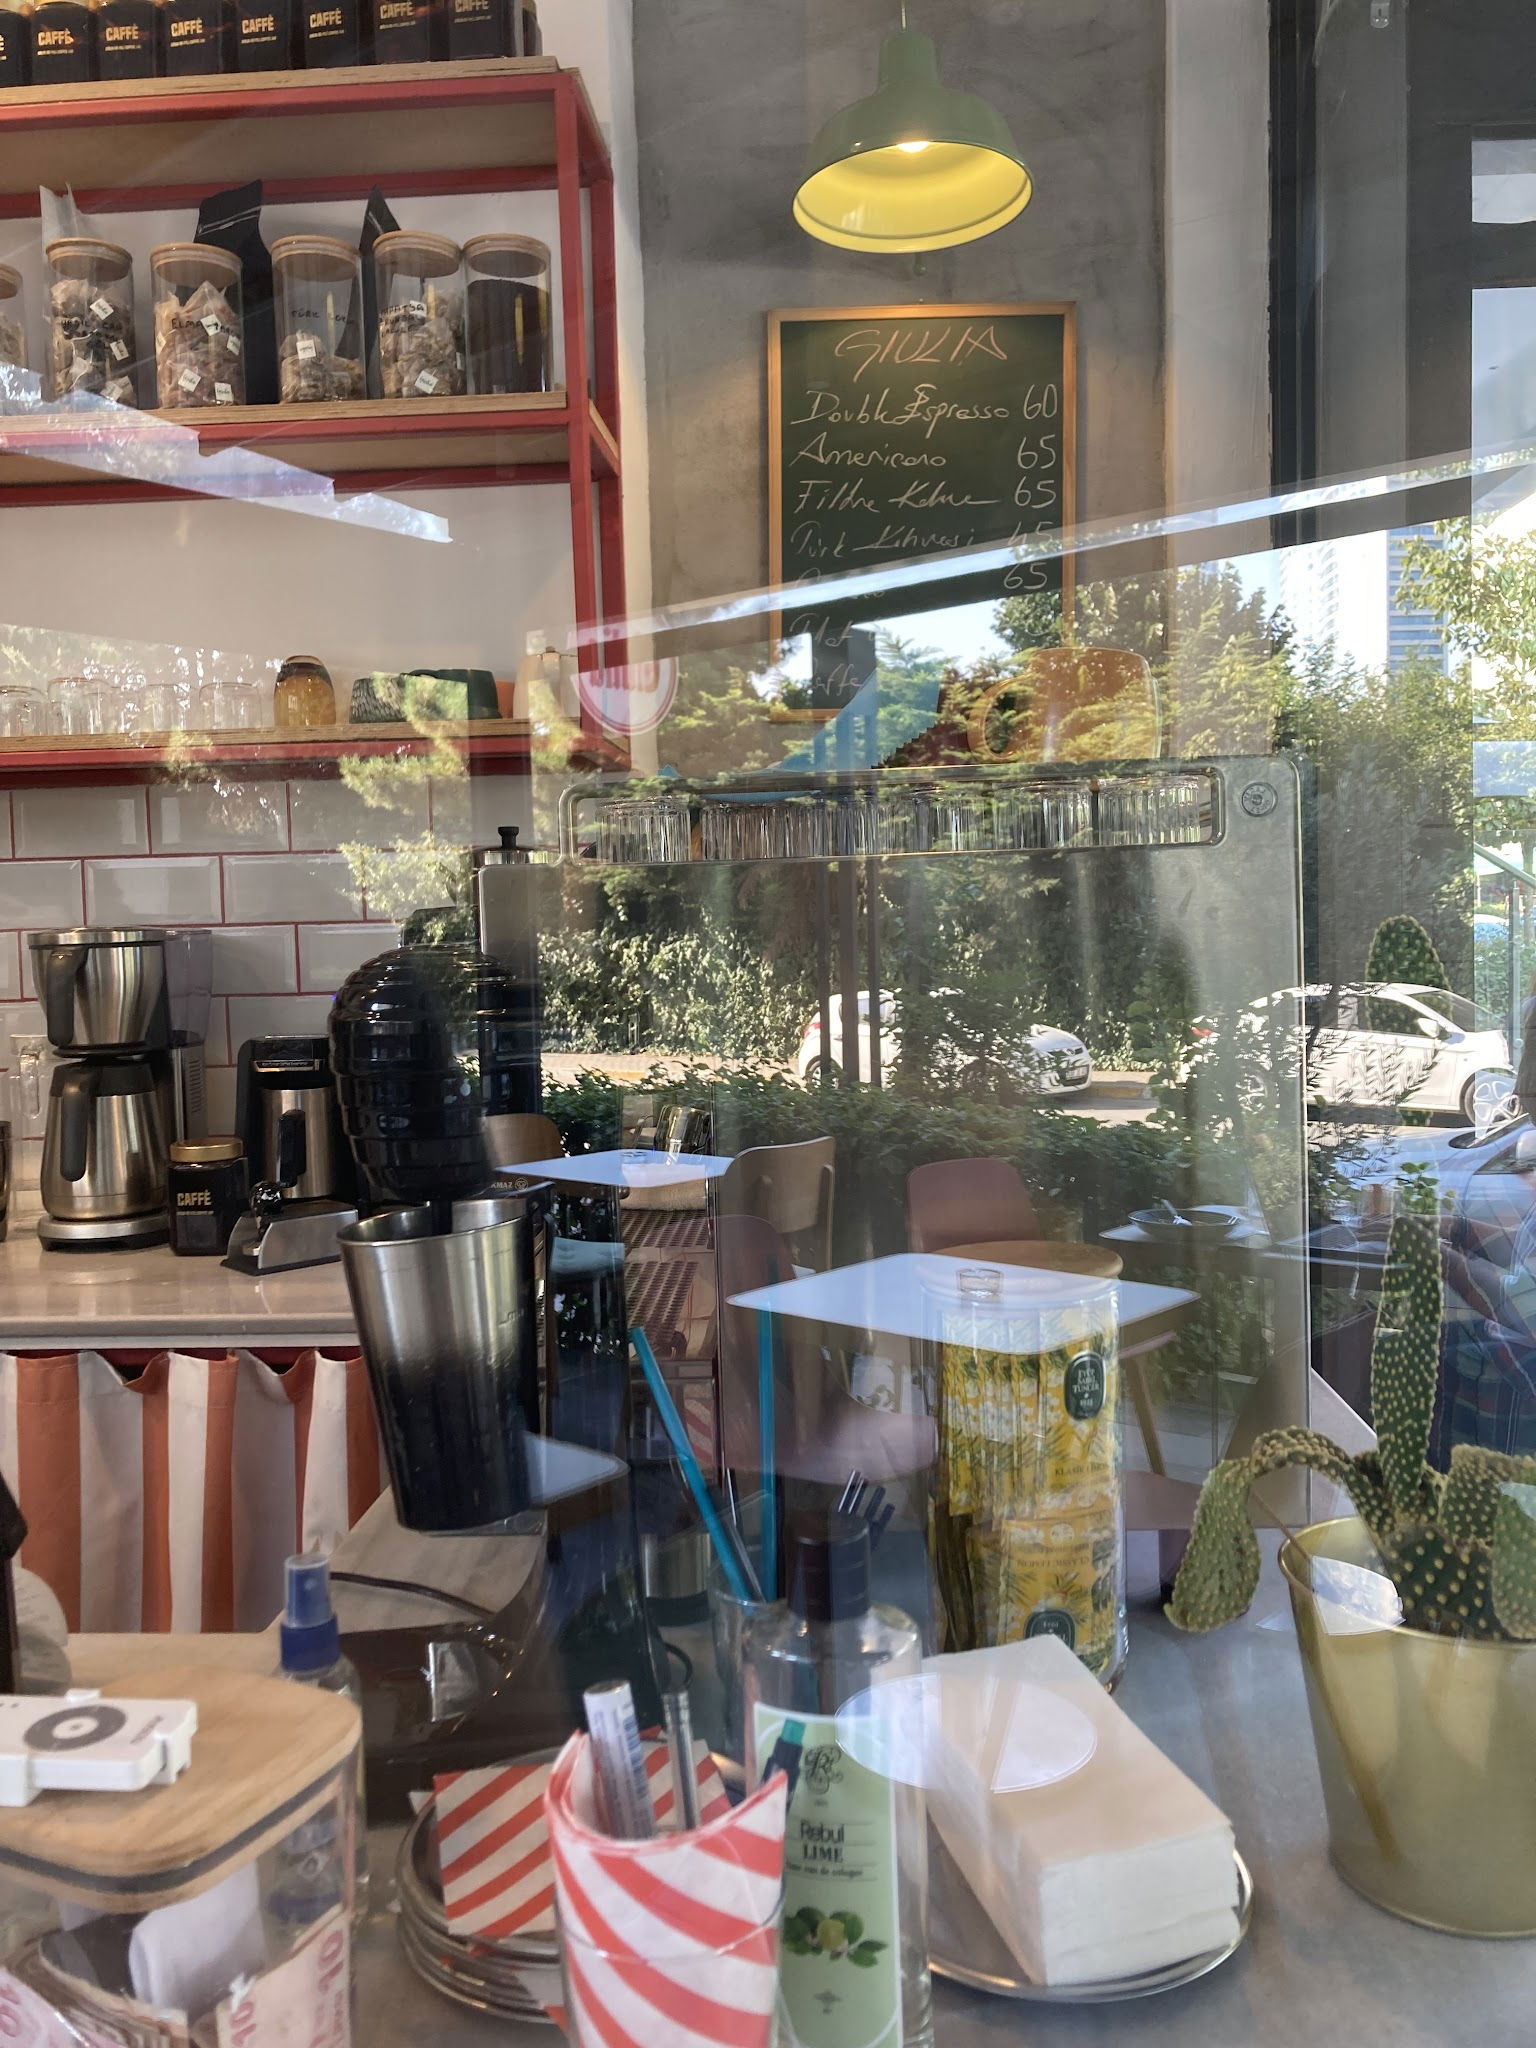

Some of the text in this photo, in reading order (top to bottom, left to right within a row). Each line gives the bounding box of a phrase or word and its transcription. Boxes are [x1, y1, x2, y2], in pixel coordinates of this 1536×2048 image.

[834, 326, 1008, 383] GIULIA
[1023, 383, 1058, 420] 60
[789, 431, 1057, 470] Americano 65
[1013, 476, 1057, 509] 65
[1003, 562, 1049, 590] 65
[802, 1844, 844, 1863] LIME
